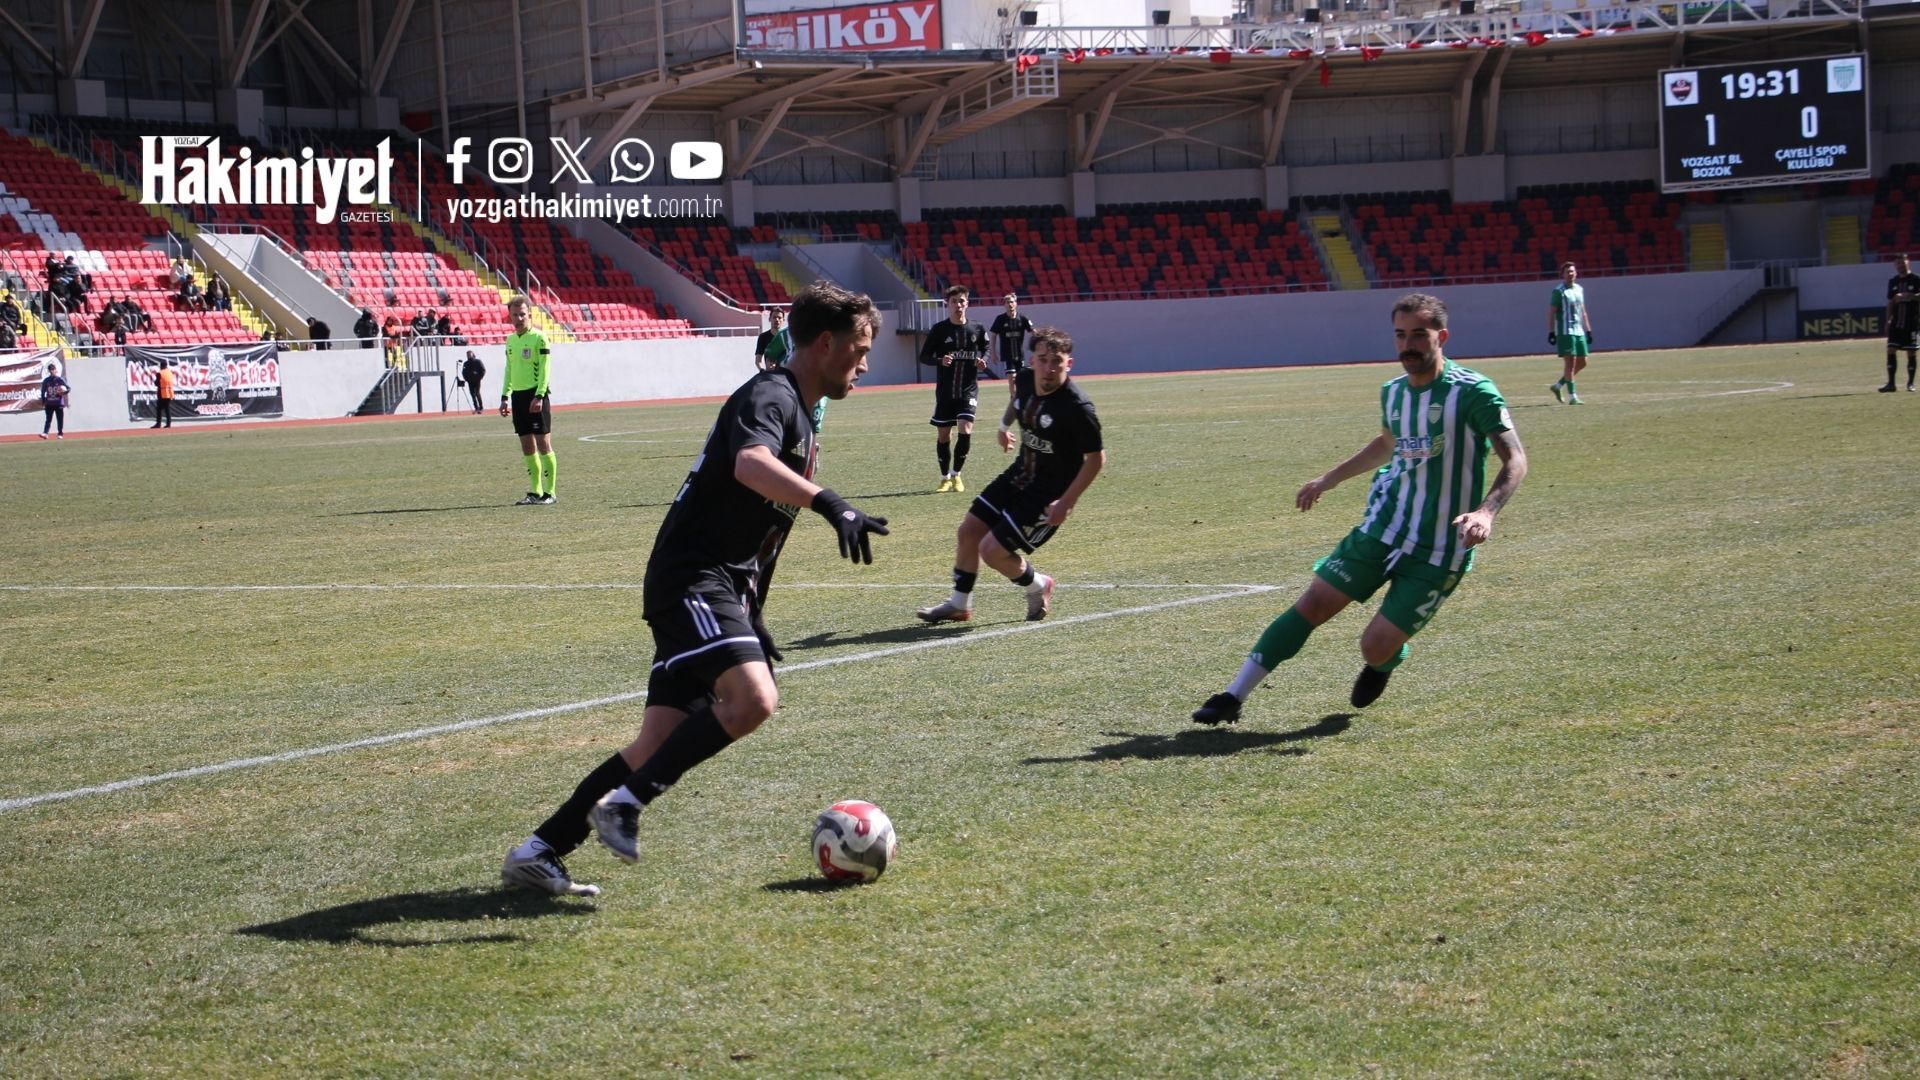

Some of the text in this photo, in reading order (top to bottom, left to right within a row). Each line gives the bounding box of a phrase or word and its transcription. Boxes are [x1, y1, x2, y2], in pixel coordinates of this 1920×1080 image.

[1721, 68, 1799, 100] 19:31
[1705, 114, 1716, 146] 1
[1801, 106, 1818, 138] 0
[1681, 153, 1743, 168] YOZGAT BL
[1815, 144, 1847, 157] SPOR
[1692, 166, 1733, 179] BOZOK
